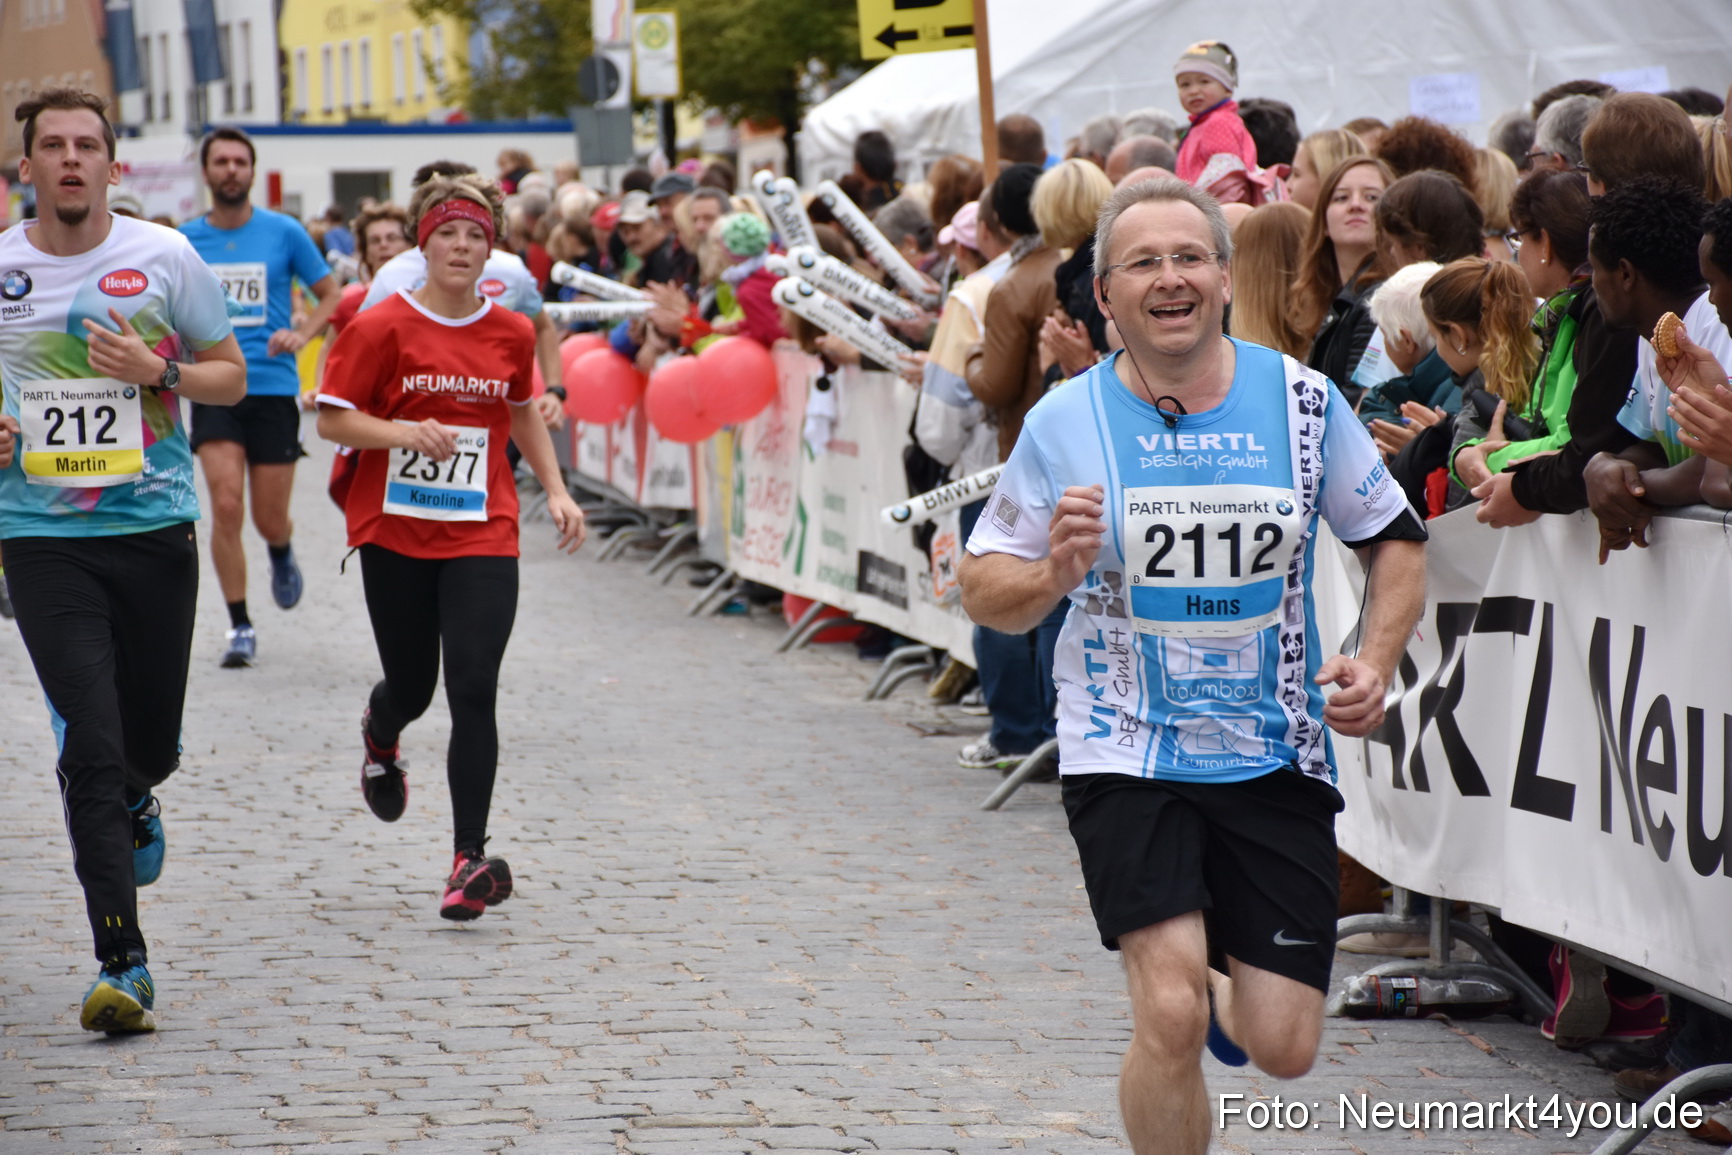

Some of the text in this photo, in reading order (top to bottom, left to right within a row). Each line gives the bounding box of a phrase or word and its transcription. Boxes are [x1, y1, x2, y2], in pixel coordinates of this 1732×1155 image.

[105, 277, 143, 290] Hervis
[823, 266, 862, 294] BMW
[2, 303, 35, 316] PARTL
[3, 311, 35, 322] Neumarkt
[23, 389, 118, 401] PARTL Neumarkt
[402, 374, 501, 397] NEUMARKT
[44, 406, 117, 446] 212
[1136, 433, 1265, 451] VIERTL
[56, 456, 106, 473] Martin
[399, 448, 479, 484] 2377
[1139, 452, 1269, 470] DESIGN GmbH
[1299, 422, 1311, 517] VIERTL
[410, 489, 465, 508] Karoline
[923, 480, 971, 510] BMW
[1129, 500, 1269, 516] PARTL Neumarkt
[1145, 522, 1284, 578] 2112
[1186, 595, 1241, 616] Hans
[1108, 627, 1134, 698] GmbH
[1169, 680, 1259, 700] raumbox
[1357, 596, 1577, 822] ARTL
